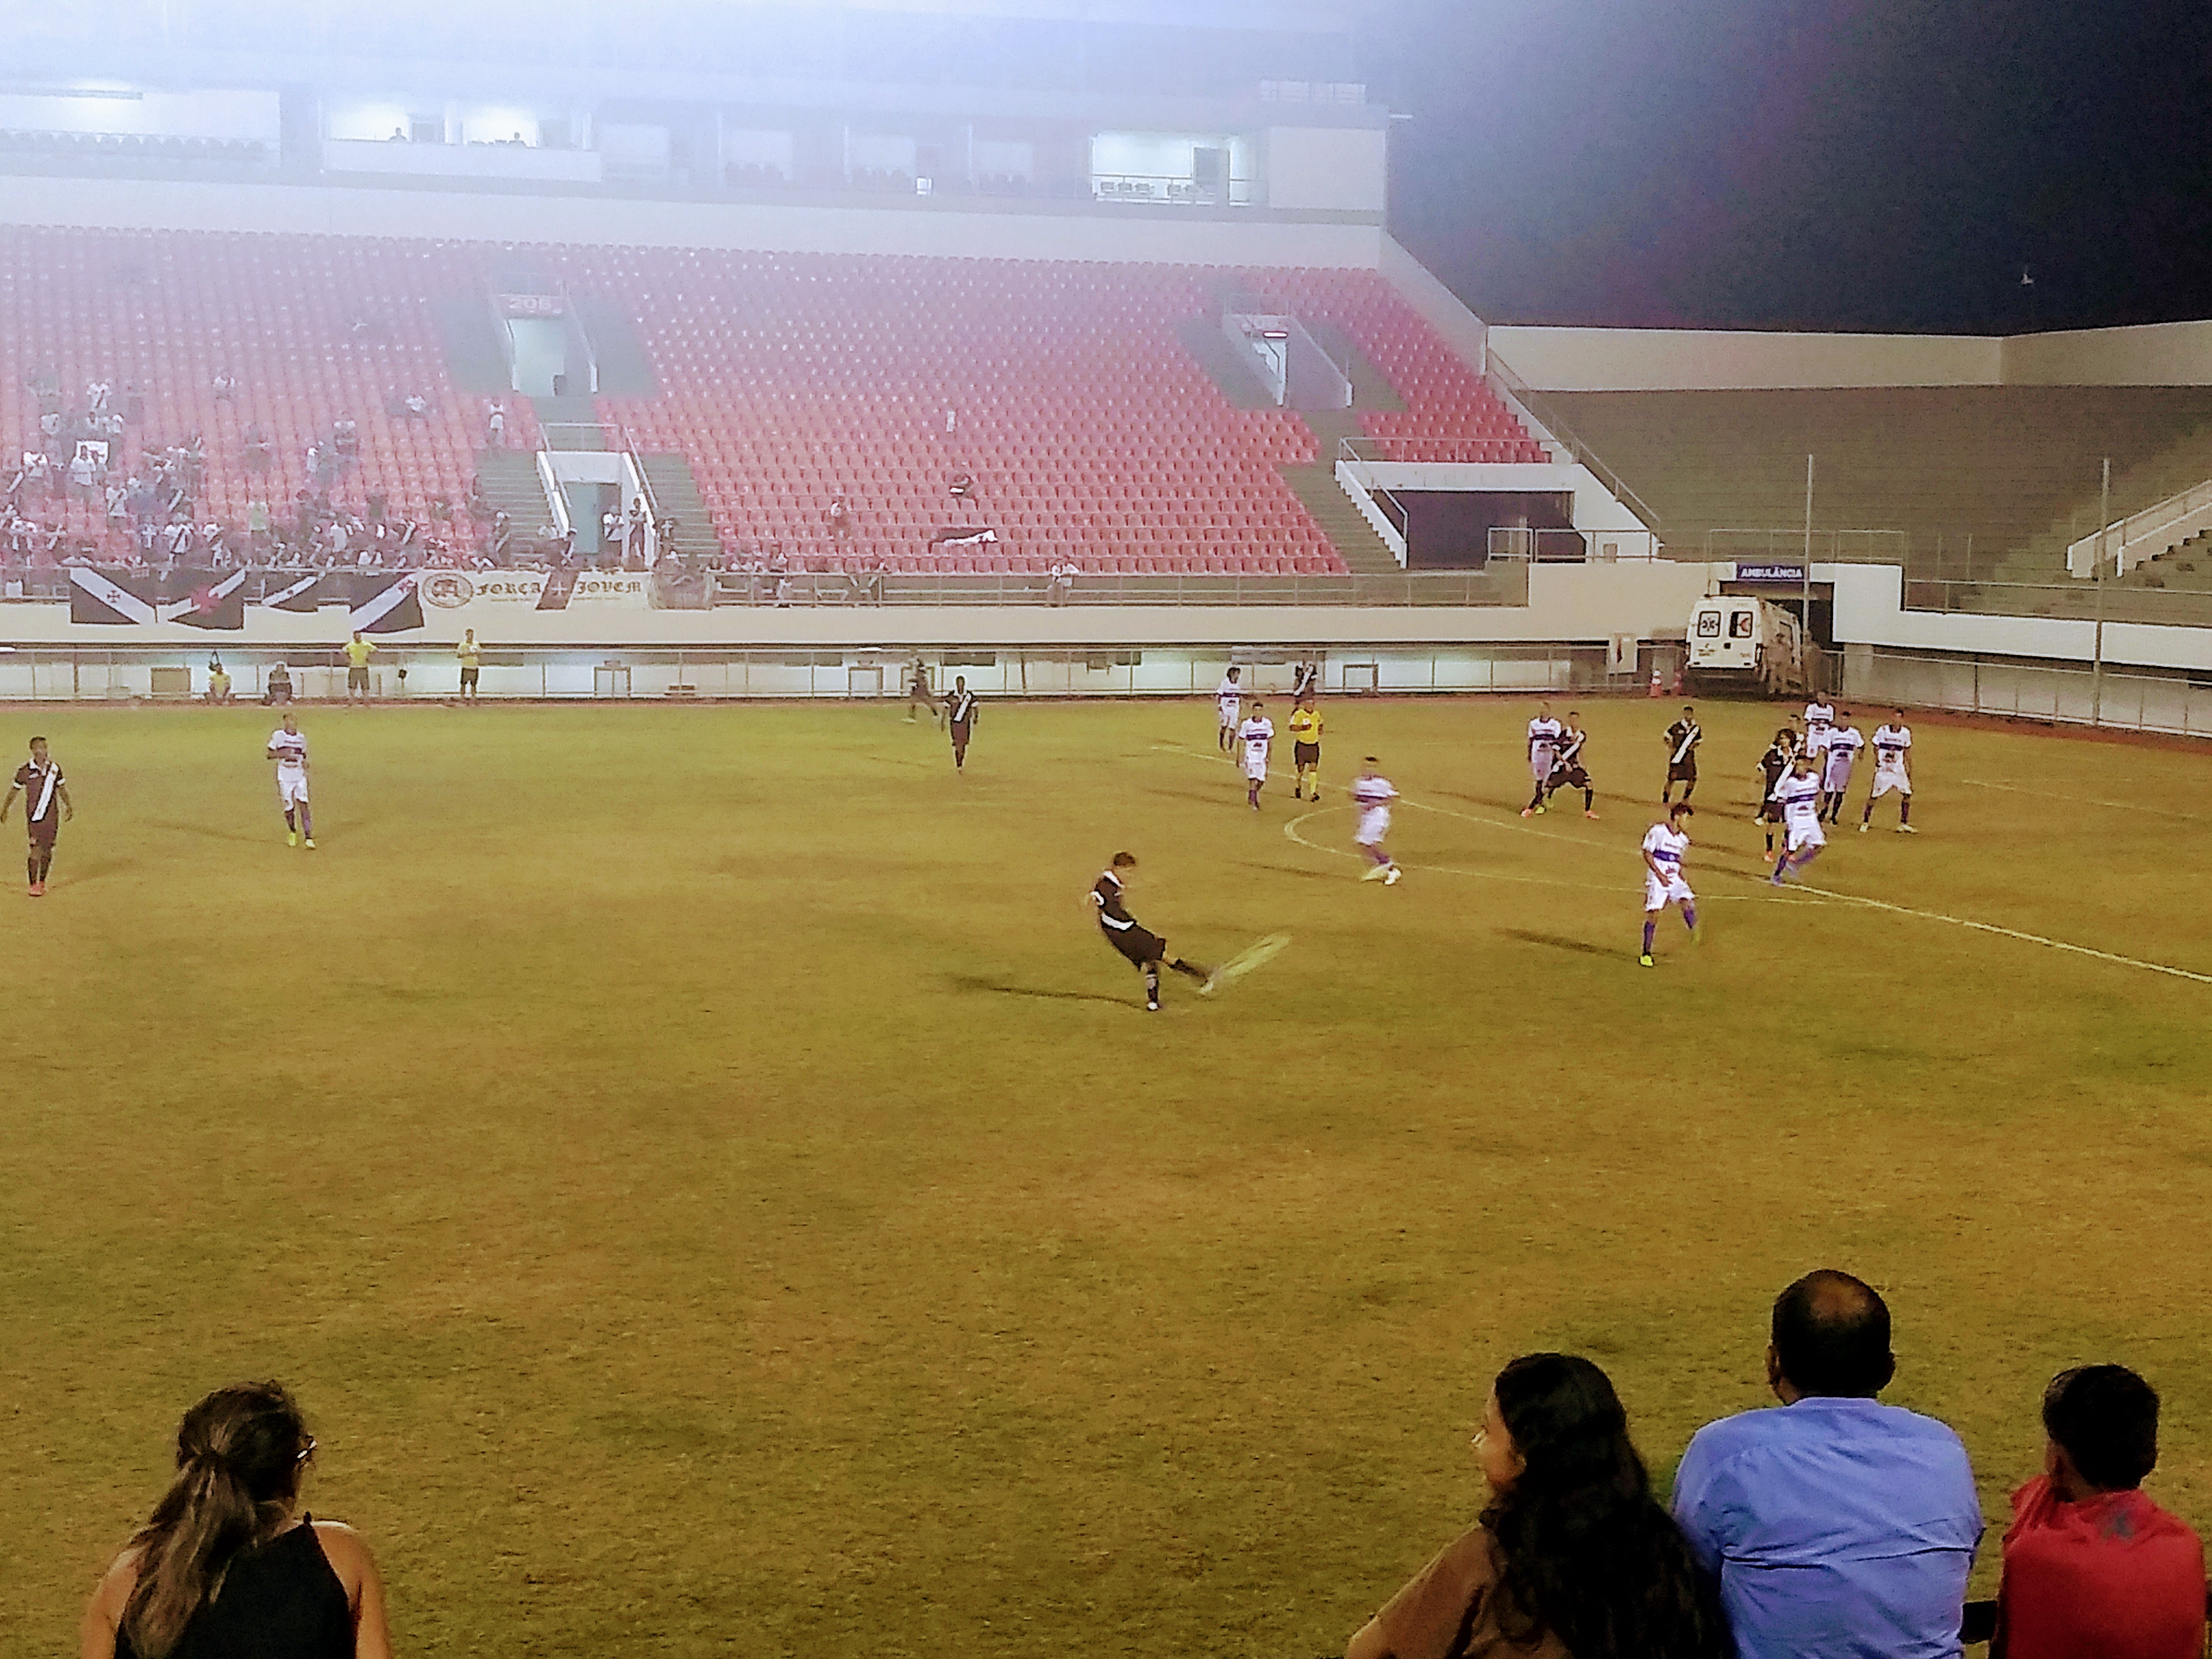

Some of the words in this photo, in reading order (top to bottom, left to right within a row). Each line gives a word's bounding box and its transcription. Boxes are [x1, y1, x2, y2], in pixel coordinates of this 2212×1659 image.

[1741, 566, 1802, 578] AMBULÂNCIA
[476, 583, 541, 596] FORÇA
[577, 581, 641, 594] JOVEM
